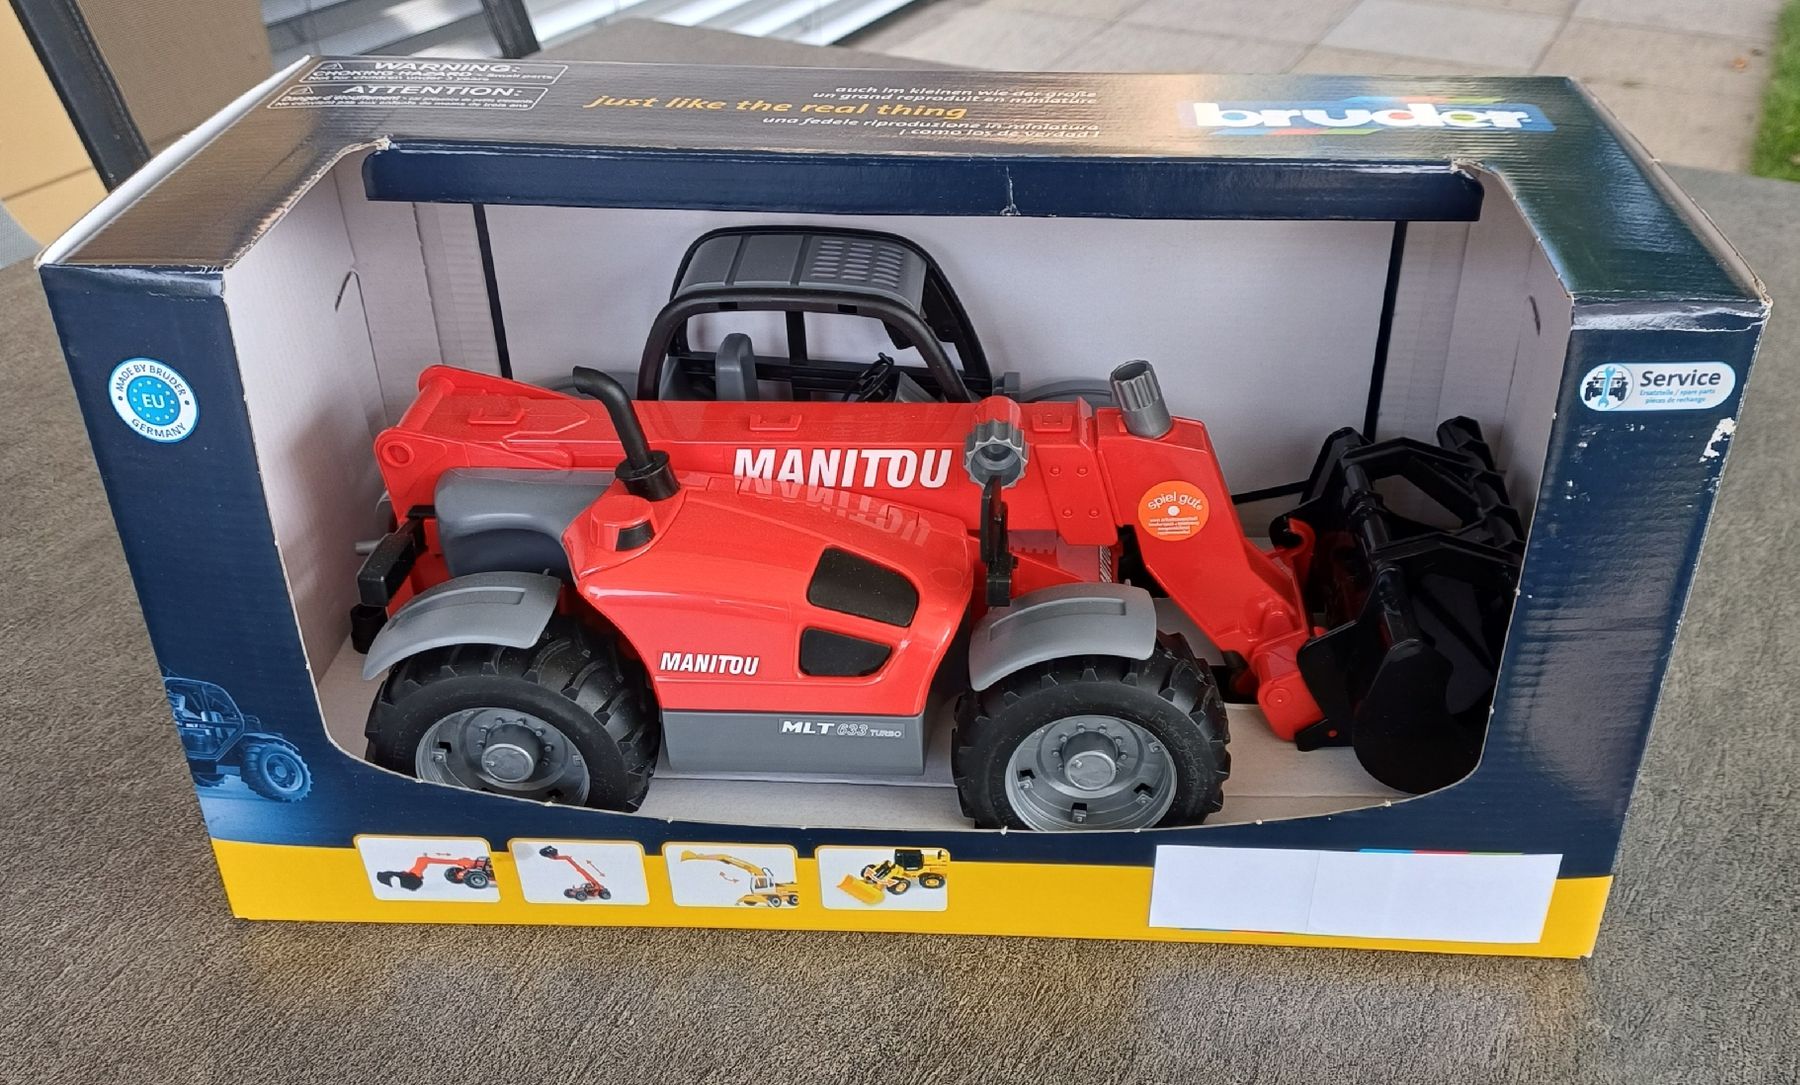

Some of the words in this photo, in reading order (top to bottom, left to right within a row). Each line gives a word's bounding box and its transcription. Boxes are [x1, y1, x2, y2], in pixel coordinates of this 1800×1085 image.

[375, 62, 521, 72] WARNING:
[342, 85, 522, 96] ATTENTION:
[909, 88, 973, 96] kleinen
[1045, 91, 1097, 99] große
[582, 96, 660, 109] just
[664, 98, 728, 110] like
[736, 101, 793, 112] the
[800, 104, 870, 114] real
[876, 105, 968, 120] thing
[1193, 102, 1530, 129] bruder
[799, 118, 859, 126] fedele
[863, 120, 981, 128] riproduzione
[115, 367, 135, 392] MADE
[133, 364, 146, 374] BY
[149, 365, 187, 396] BRUDER
[1639, 369, 1721, 387] Service
[141, 393, 165, 409] EU
[131, 418, 187, 438] GERMANY
[733, 448, 954, 489] MANITOU
[1148, 491, 1177, 509] spiel
[659, 652, 760, 676] MANITOU
[781, 720, 835, 735] MLT
[836, 723, 868, 736] 633
[869, 728, 902, 738] TURBO
